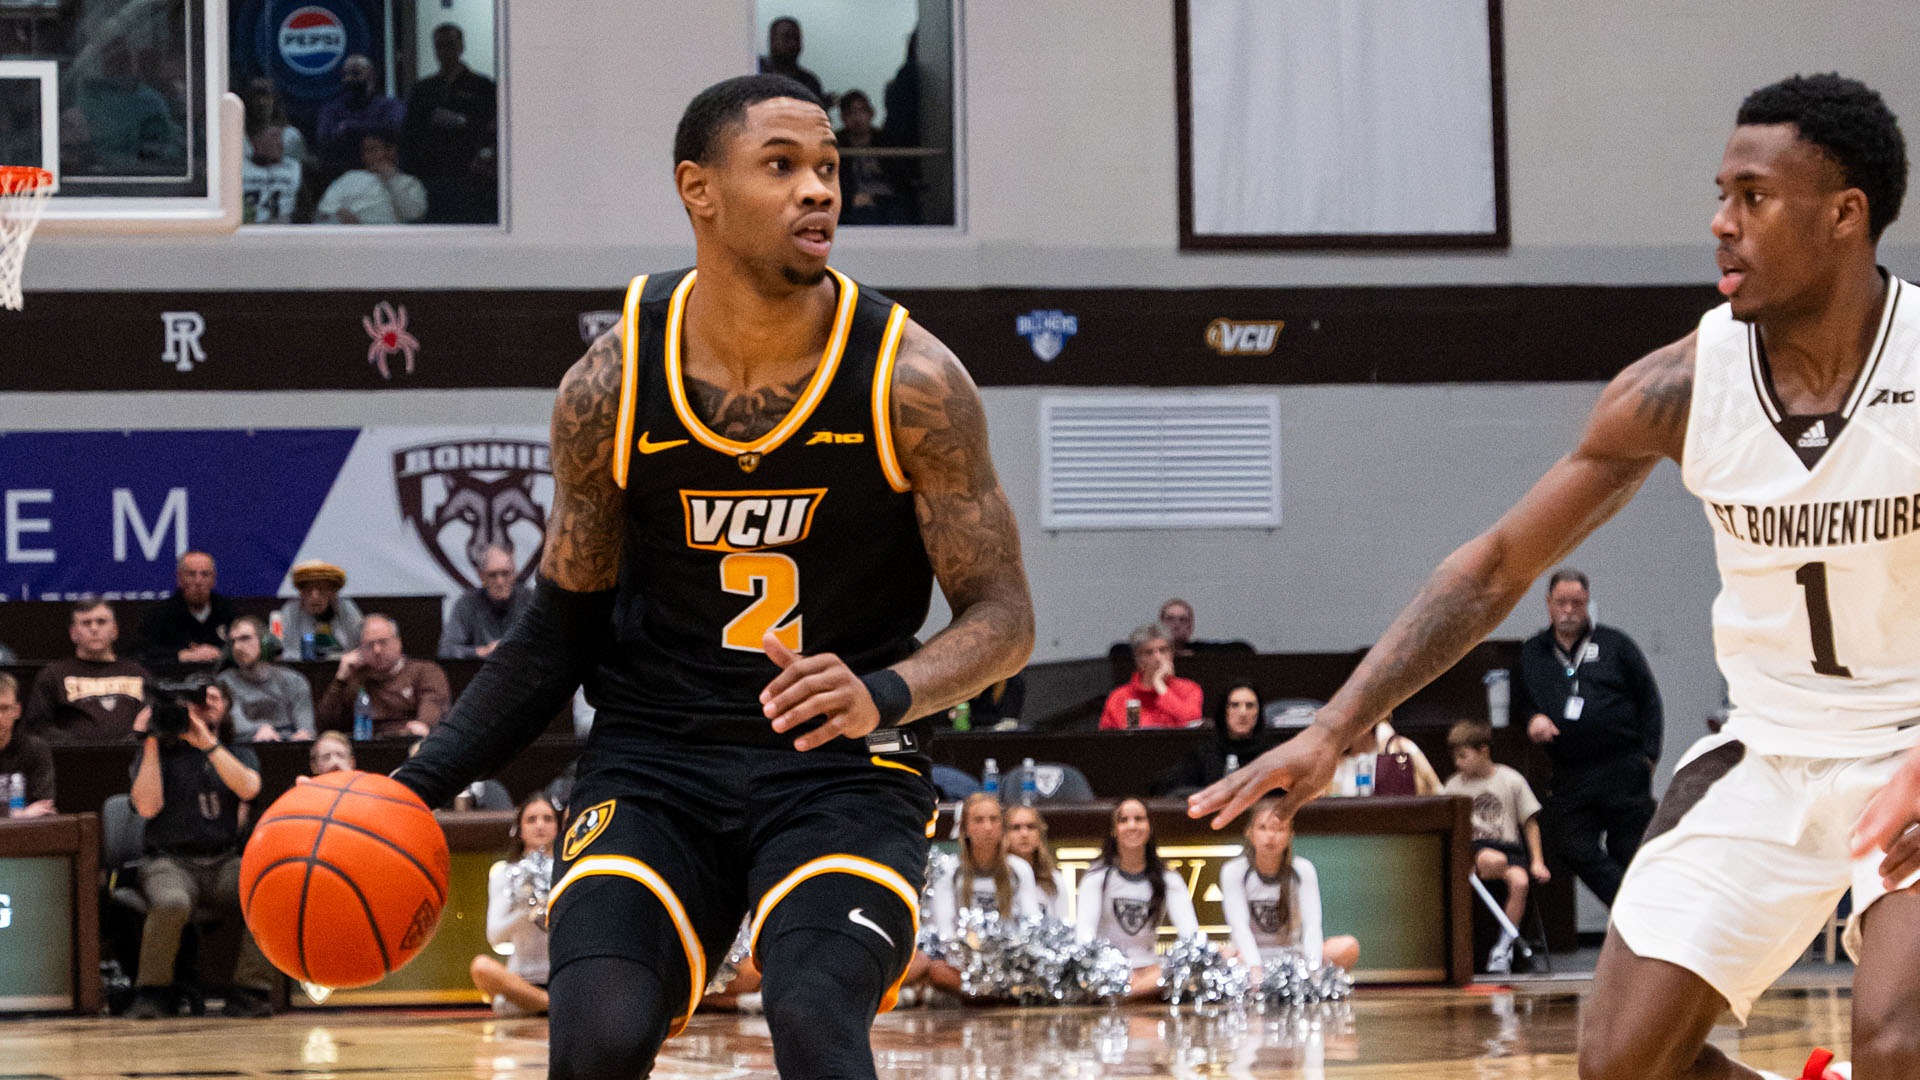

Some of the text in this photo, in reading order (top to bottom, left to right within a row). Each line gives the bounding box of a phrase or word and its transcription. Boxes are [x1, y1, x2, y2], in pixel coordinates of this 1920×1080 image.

[284, 32, 340, 46] PEPSI
[1220, 321, 1278, 353] VCU
[805, 431, 865, 445] A10
[402, 443, 551, 475] BONNIE
[690, 498, 811, 546] VCU
[1710, 493, 1920, 548] ST. BONAVENTURE
[719, 552, 803, 653] 2
[1795, 561, 1853, 679] 1
